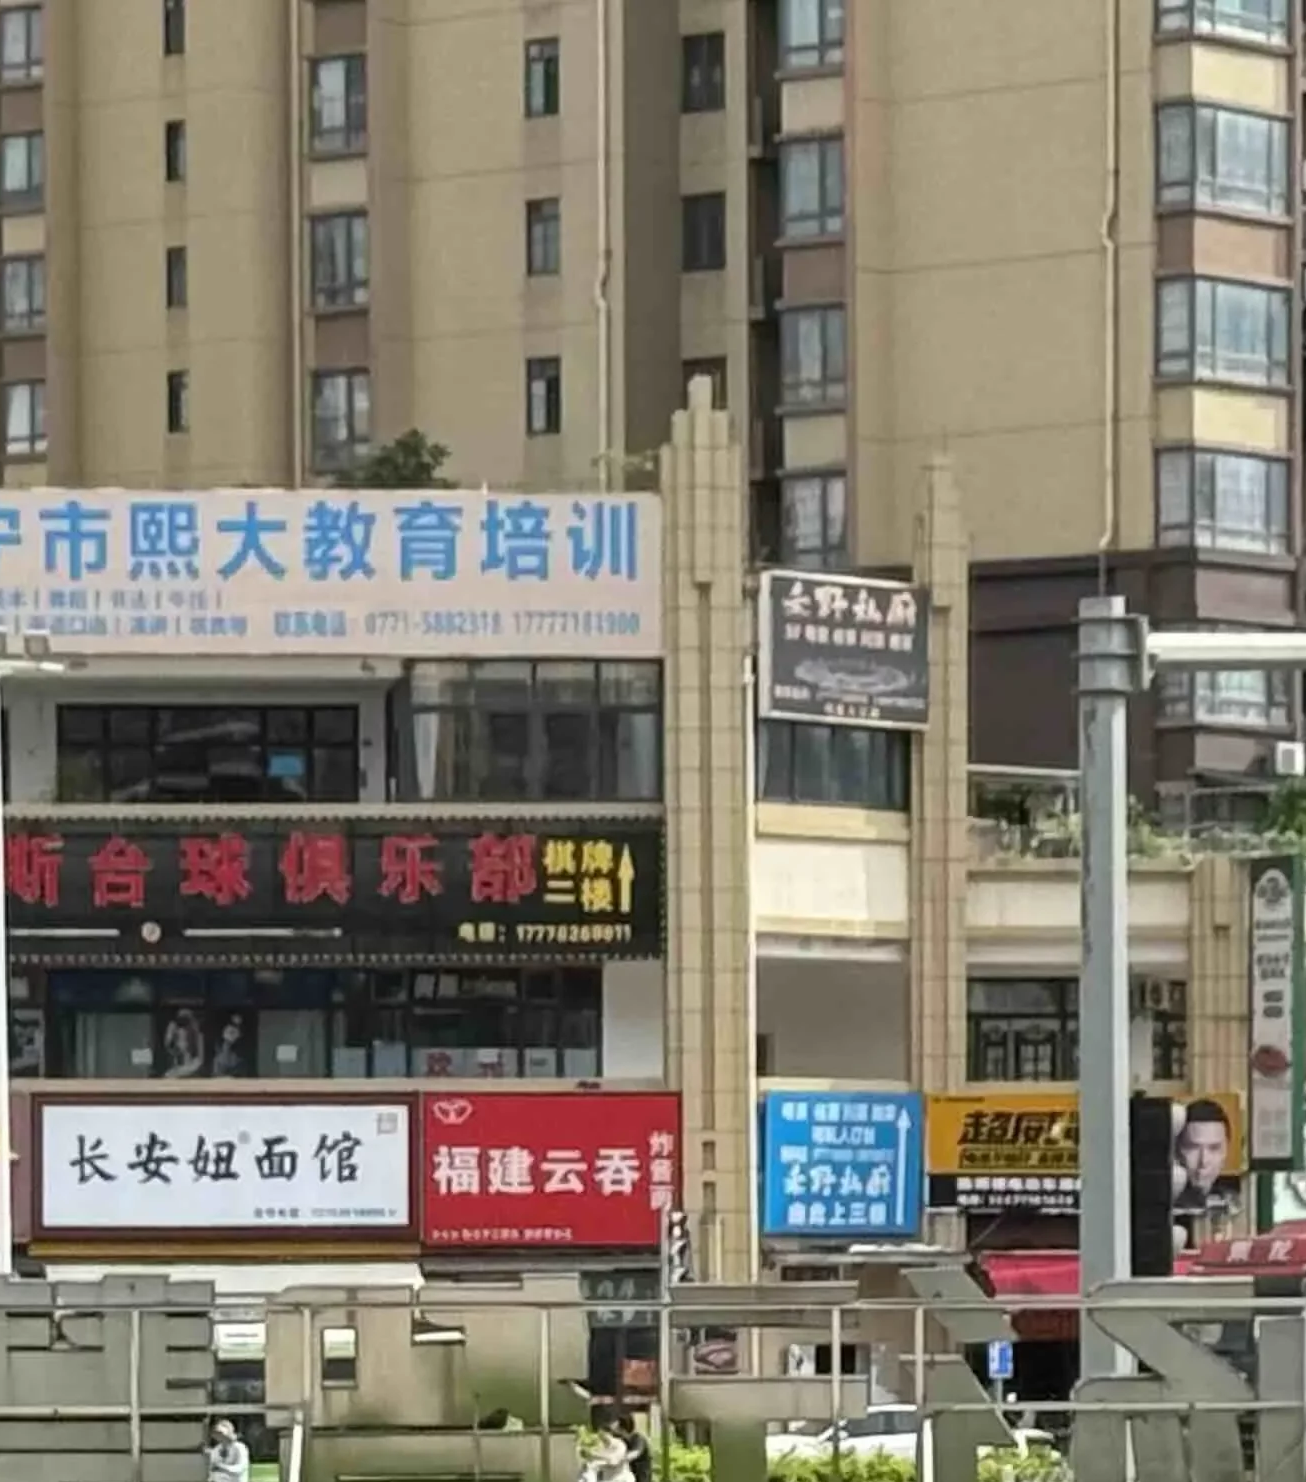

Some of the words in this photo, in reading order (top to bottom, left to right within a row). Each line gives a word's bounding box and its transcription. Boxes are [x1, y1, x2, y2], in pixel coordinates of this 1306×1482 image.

[544, 876, 614, 913] 二楼
[69, 1131, 365, 1184] 长安妞面馆
[432, 1145, 643, 1197] 福建云吞
